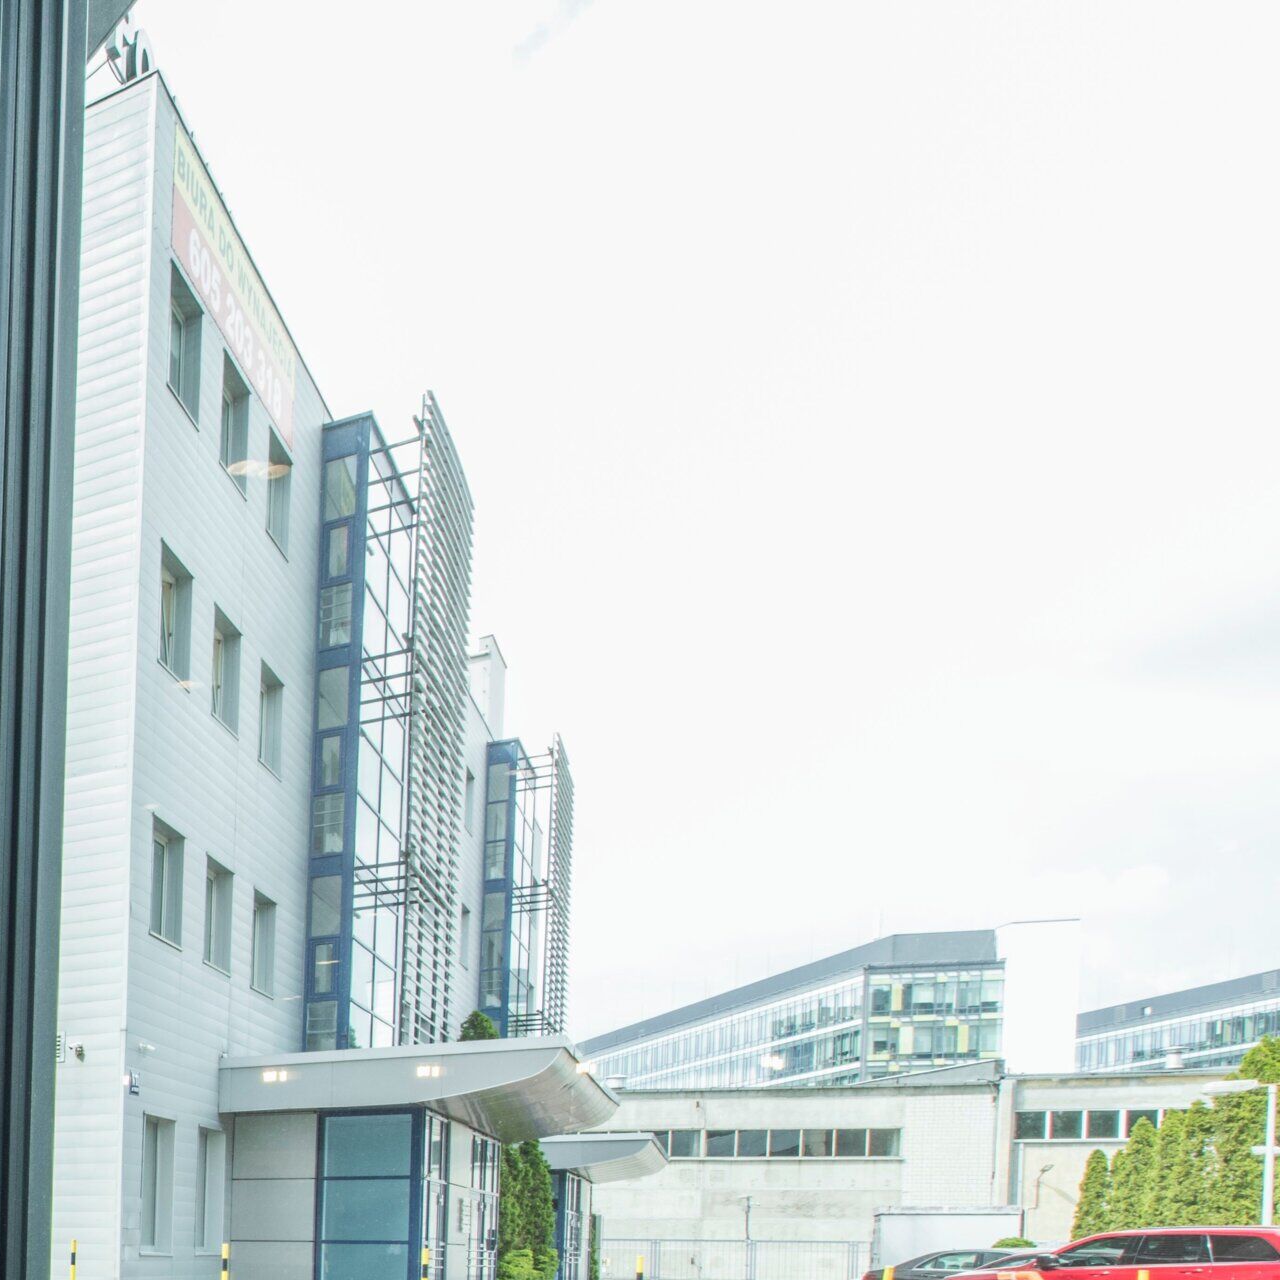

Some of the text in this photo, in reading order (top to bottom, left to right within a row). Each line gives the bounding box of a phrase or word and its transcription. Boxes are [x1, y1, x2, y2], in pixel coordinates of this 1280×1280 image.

[177, 145, 215, 241] BIURA
[219, 222, 234, 274] DO
[188, 227, 283, 422] 605 203 318
